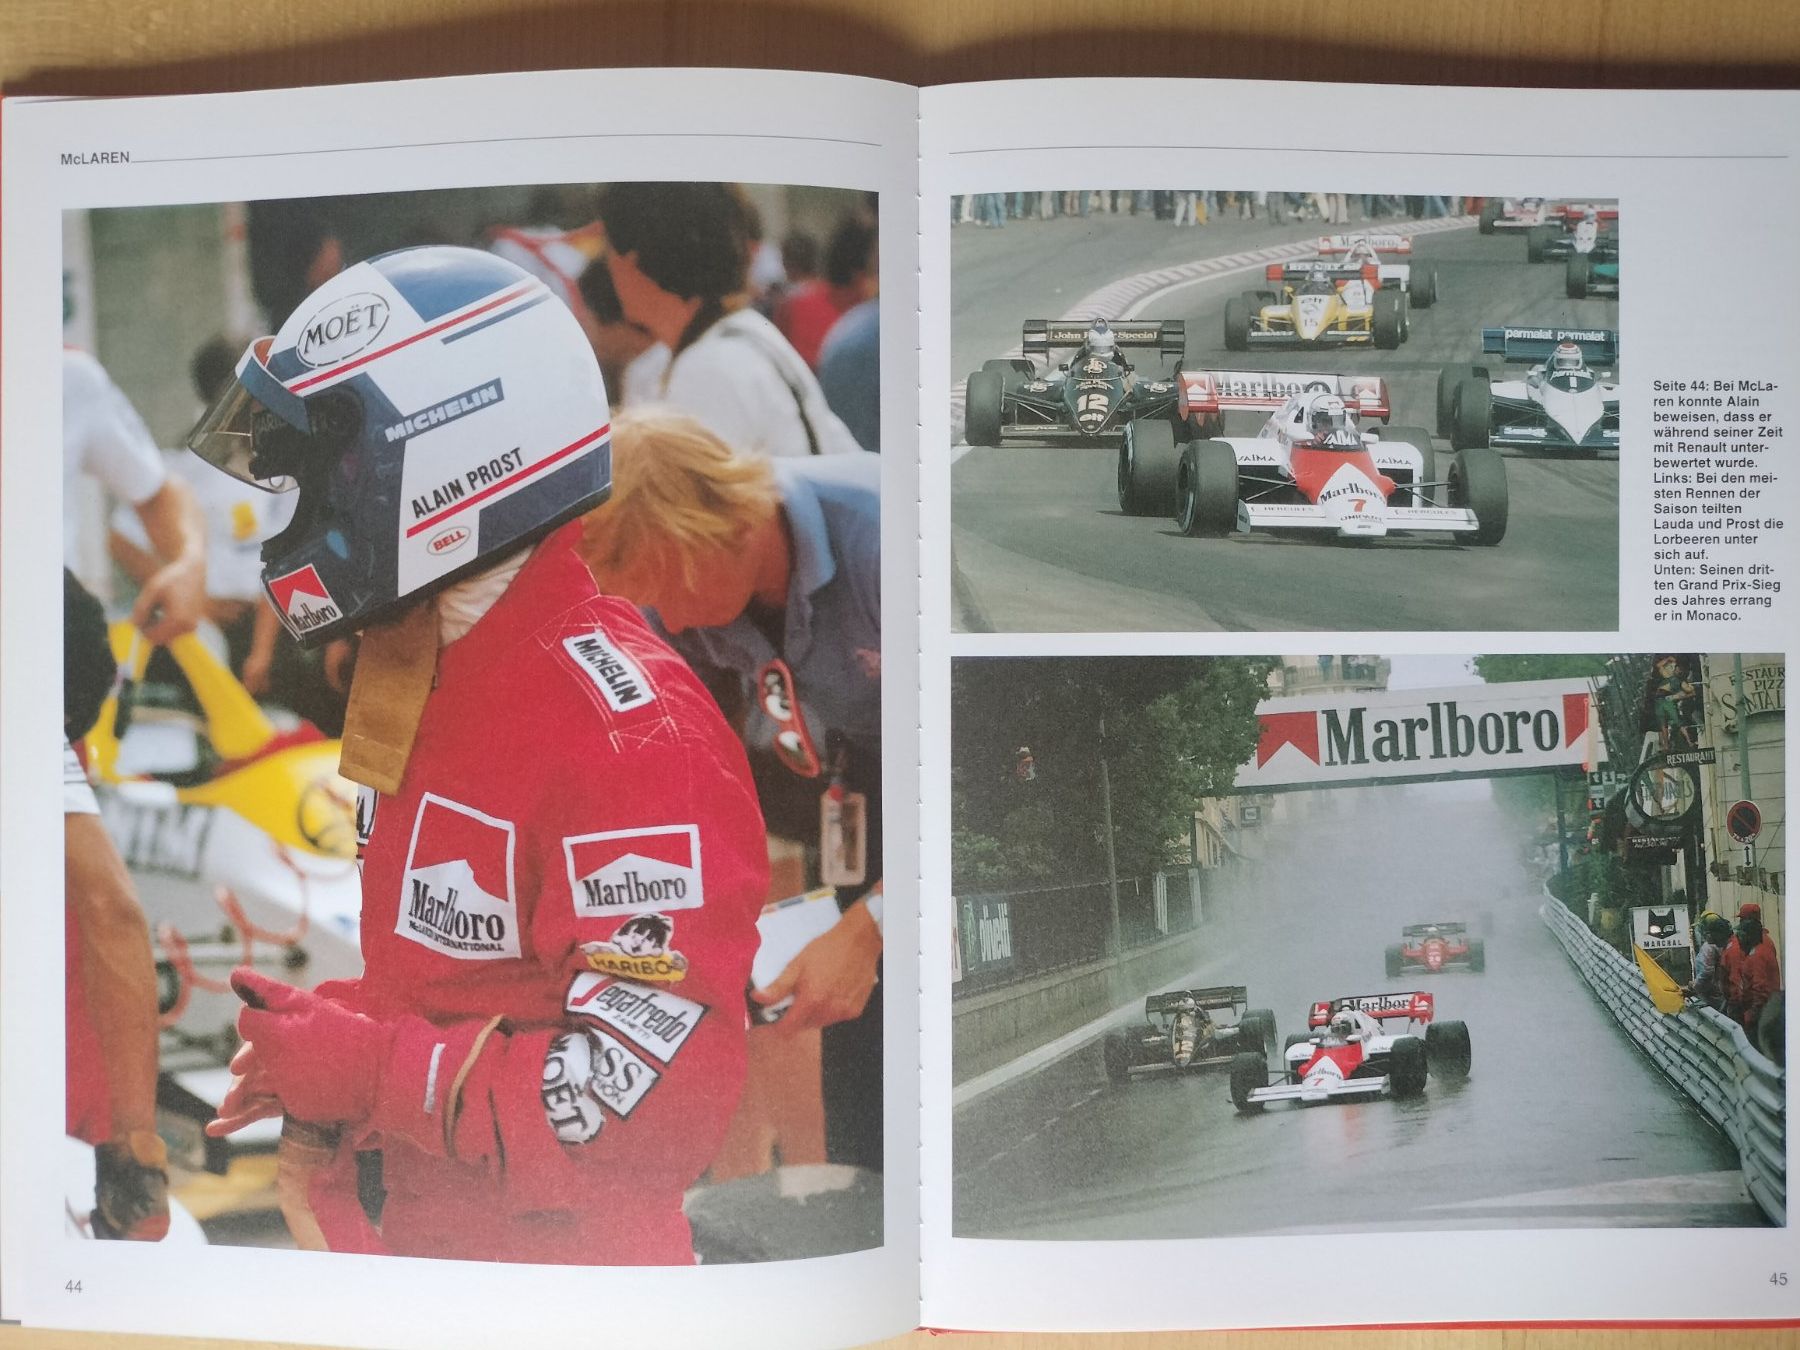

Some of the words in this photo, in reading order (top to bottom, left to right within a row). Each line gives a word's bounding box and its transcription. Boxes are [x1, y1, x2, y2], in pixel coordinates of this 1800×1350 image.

[60, 151, 130, 165] McLAREN
[303, 302, 384, 355] MOËT
[1055, 331, 1081, 340] John
[1505, 329, 1553, 340] parmalat
[1653, 379, 1687, 392] Seite
[1690, 379, 1710, 392] 44:
[1713, 379, 1735, 392] Bei
[1738, 379, 1779, 392] McLa-
[1077, 393, 1109, 412] 12
[1653, 397, 1674, 407] ren
[1678, 395, 1723, 408] konnte
[1726, 395, 1760, 408] Alain
[384, 383, 499, 443] MICHELIN
[1653, 410, 1720, 425] beweisen,
[1723, 410, 1755, 424] dass
[1758, 413, 1773, 425] er
[1653, 425, 1710, 438] während
[1713, 426, 1755, 438] seiner
[1757, 425, 1784, 438] Zeit
[1653, 441, 1674, 453] mit
[1677, 441, 1728, 454] Renault
[1730, 441, 1770, 454] unter-
[1653, 456, 1712, 469] bewertet
[1714, 455, 1758, 469] wurde.
[411, 478, 466, 519] ALAIN
[465, 447, 525, 494] PROST
[1653, 471, 1692, 485] Links:
[1695, 471, 1718, 484] Bei
[1720, 471, 1746, 484] den
[1749, 471, 1779, 484] mei-
[1653, 488, 1682, 500] sten
[1685, 487, 1736, 501] Rennen
[1738, 487, 1761, 499] der
[1348, 499, 1366, 513] 7
[1653, 502, 1698, 515] Saison
[1701, 502, 1743, 515] teilten
[1653, 517, 1695, 530] Lauda
[1697, 517, 1723, 530] und
[1726, 517, 1761, 530] Prost
[1763, 517, 1784, 530] die
[433, 530, 466, 553] BELL
[1653, 533, 1721, 545] Lorbeeren
[1724, 533, 1759, 545] unter
[1653, 548, 1681, 561] sich
[1684, 548, 1709, 561] auf.
[1653, 563, 1696, 576] Unten:
[1698, 563, 1744, 576] Seinen
[1747, 563, 1775, 576] drit-
[1653, 579, 1675, 591] ten
[1678, 578, 1719, 591] Grand
[1722, 578, 1781, 593] Prix-Sieg
[1653, 594, 1679, 606] des
[1681, 594, 1726, 606] Jahres
[1729, 596, 1772, 609] errang
[1653, 612, 1668, 622] er
[1671, 609, 1683, 622] in
[1686, 609, 1742, 622] Monaco.
[572, 637, 642, 704] MICHELIN
[1321, 701, 1560, 767] Marlboro
[1666, 750, 1716, 766] RESTAURANT
[582, 872, 687, 908] Marlboro
[408, 878, 505, 942] Marlboro
[1643, 940, 1682, 948] MARCHAL
[594, 957, 671, 975] HARIBO
[1769, 1271, 1788, 1286] 45
[65, 1279, 83, 1294] 44
